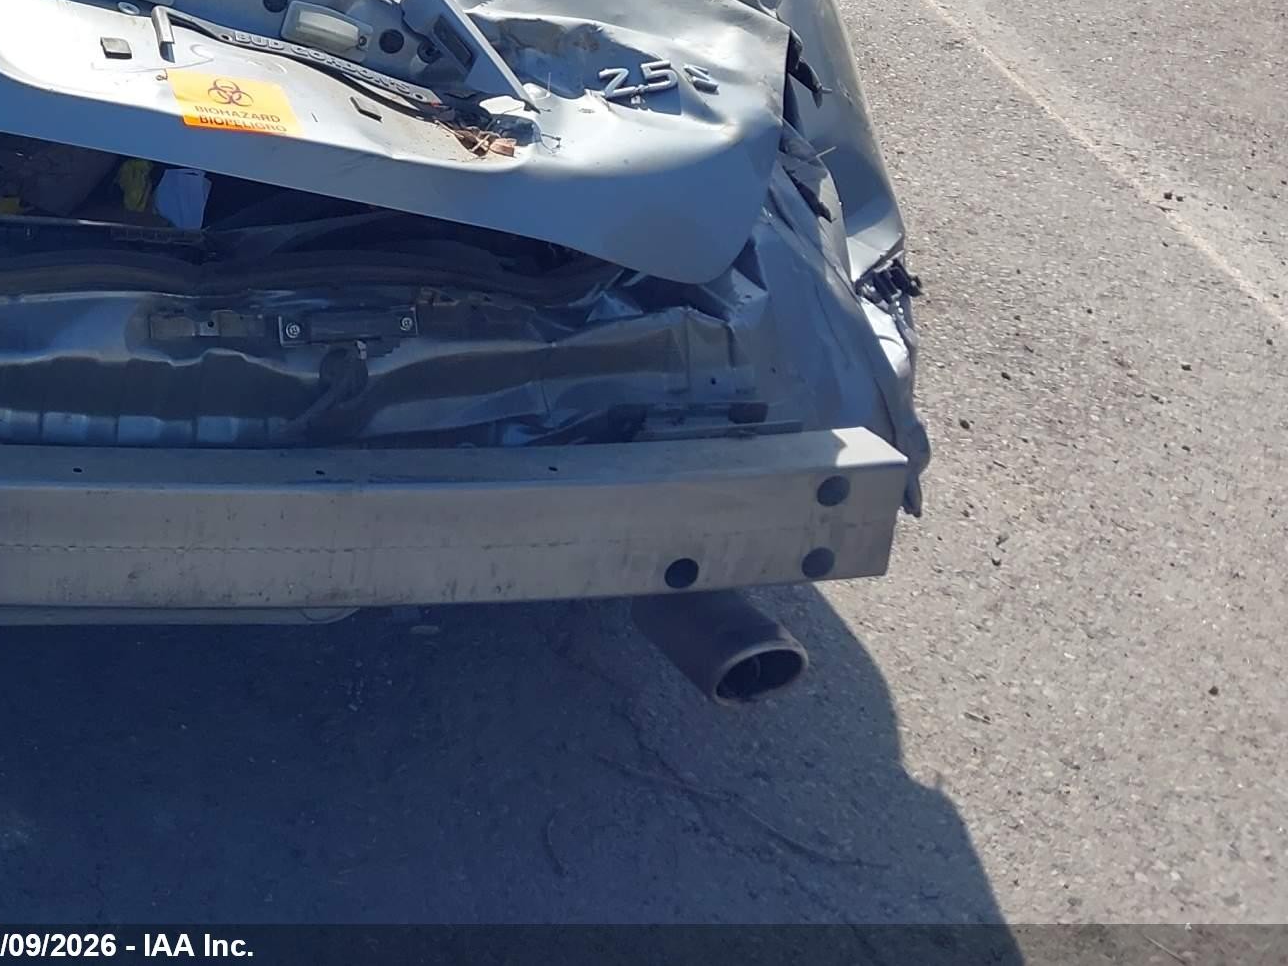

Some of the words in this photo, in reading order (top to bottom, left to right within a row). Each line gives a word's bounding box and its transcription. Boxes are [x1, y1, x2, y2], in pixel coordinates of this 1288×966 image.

[235, 31, 284, 50] BUD
[194, 105, 281, 123] BIOHAZARD
[199, 115, 287, 132] BIOPELIGRO
